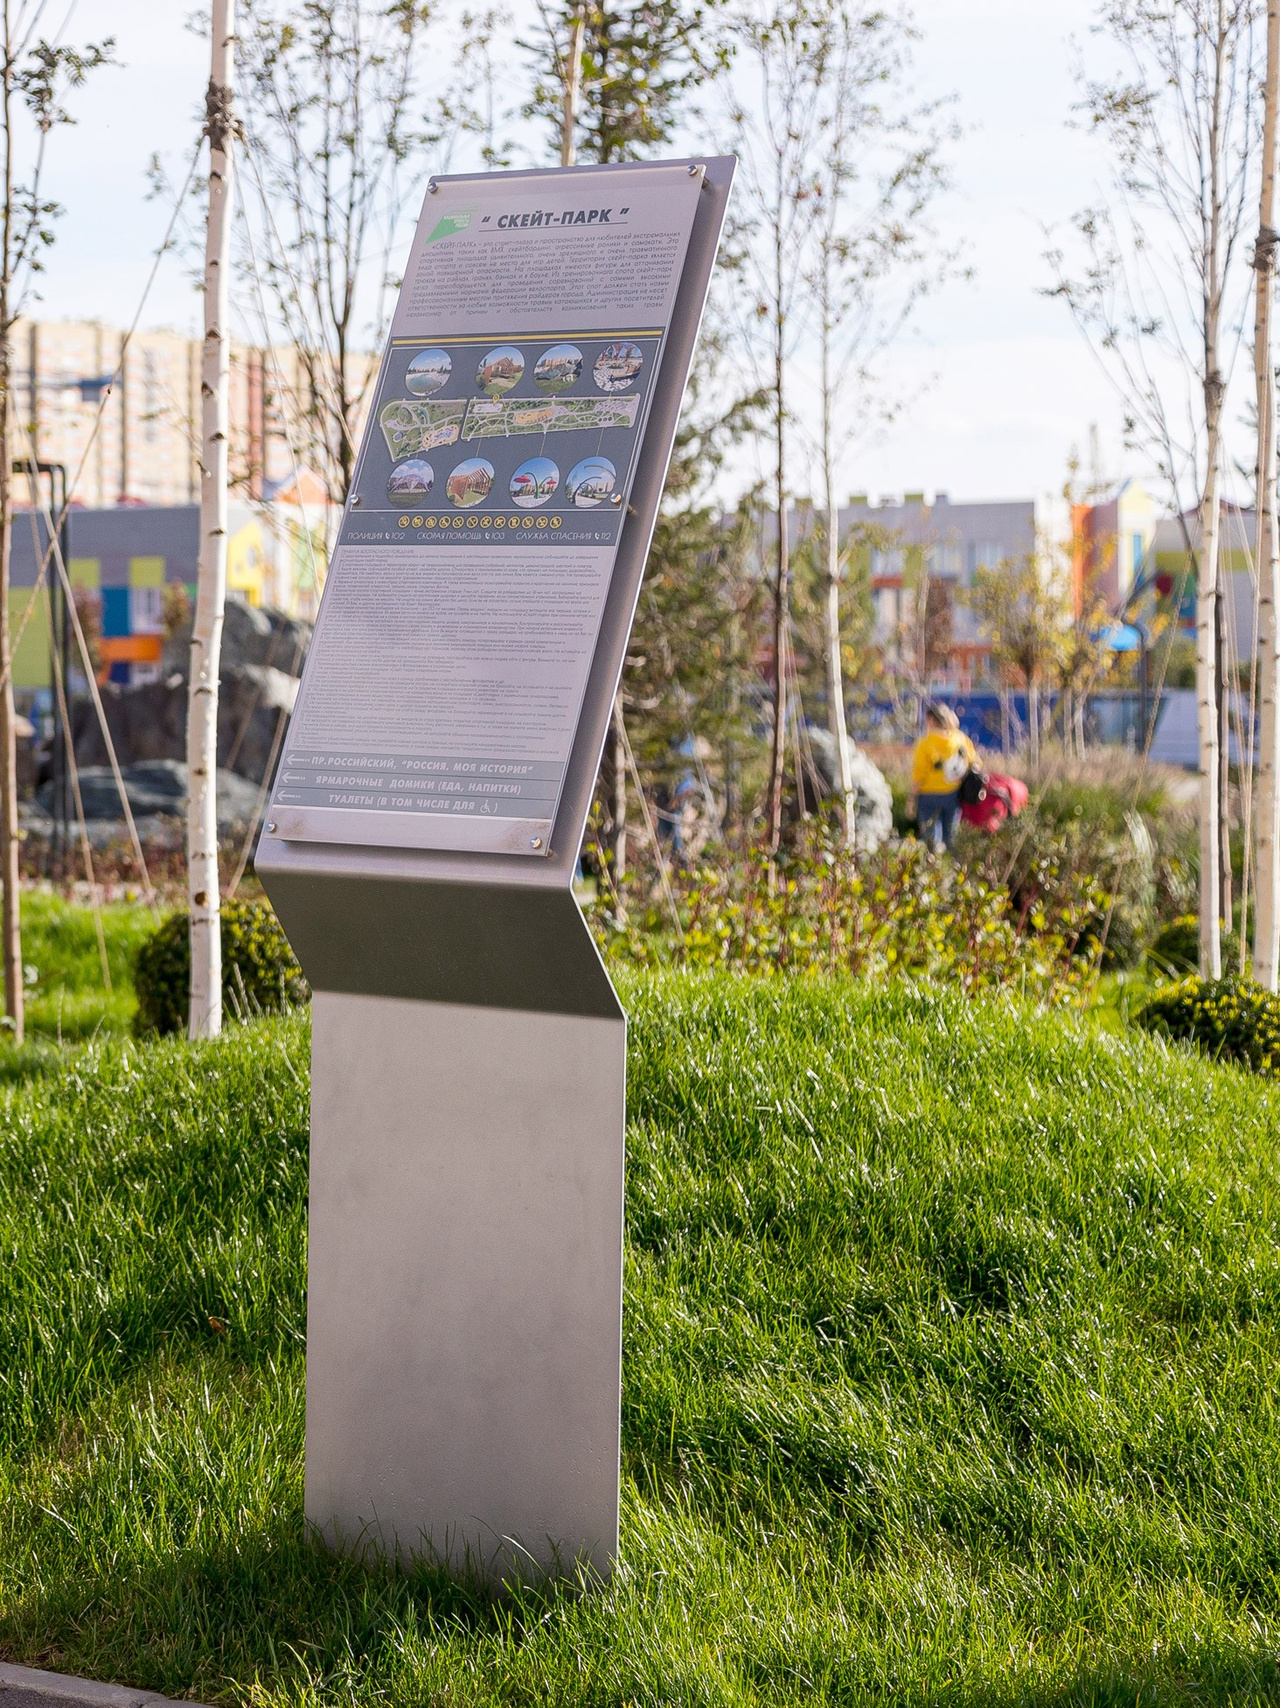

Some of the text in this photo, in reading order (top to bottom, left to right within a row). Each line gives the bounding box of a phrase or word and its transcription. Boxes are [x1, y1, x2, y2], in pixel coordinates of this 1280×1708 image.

[498, 209, 611, 227] СКЕЙТ-ПАРК
[391, 531, 405, 539] 102
[445, 531, 481, 539] ПОМОЩЬ
[491, 531, 505, 539] 103
[550, 532, 591, 540] СПАСЕНИЯ
[600, 532, 611, 540] 112
[311, 756, 396, 768] ПР.РОССИЙСКИЙ,
[453, 762, 476, 771] МОЯ
[316, 775, 521, 794] ЯРМАРОЧНЫЕ ДОМИКИ (ЕДА, НАПИТКИ)
[329, 794, 373, 804] ТУАЛЕТЫ
[376, 796, 387, 807] (В
[391, 797, 412, 806] ТОМ
[416, 799, 449, 808] ЧИСЛЕ
[452, 800, 475, 810] ДЛЯ
